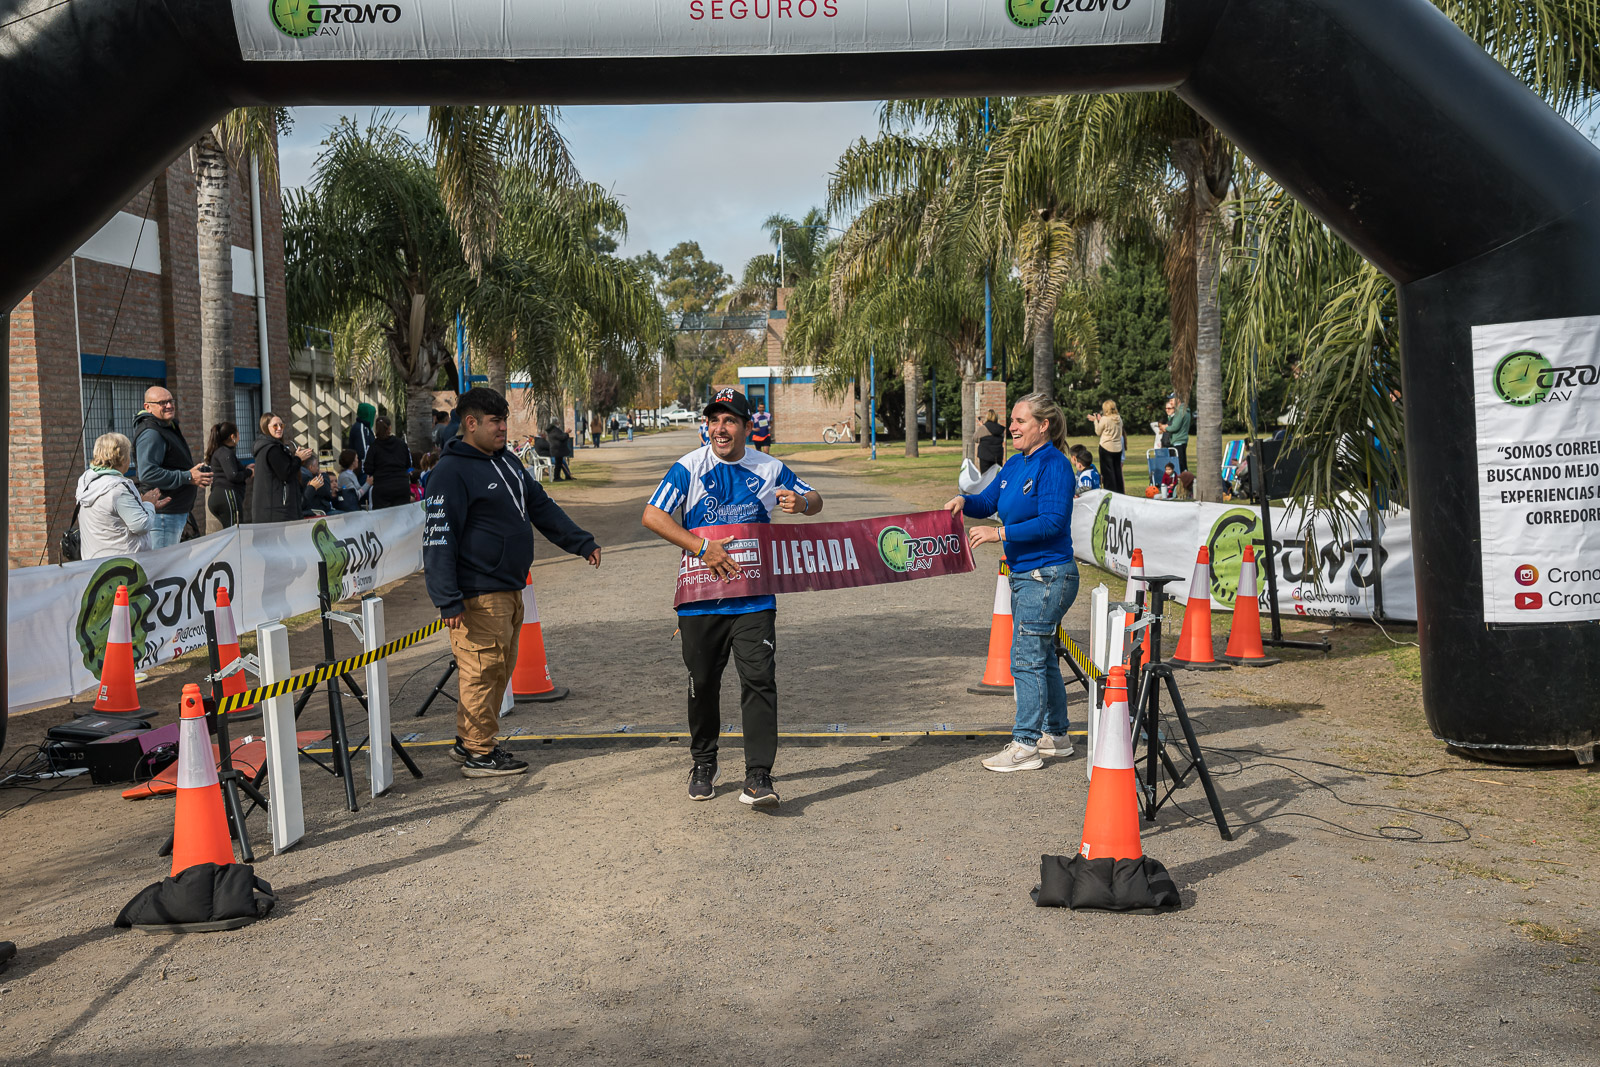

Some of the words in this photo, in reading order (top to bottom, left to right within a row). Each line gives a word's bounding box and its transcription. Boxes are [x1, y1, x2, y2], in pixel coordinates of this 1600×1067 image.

[307, 4, 402, 24] CRONO
[689, 0, 839, 21] SEGUROS
[1037, 16, 1070, 26] RAV
[307, 26, 340, 37] RAV
[1536, 364, 1600, 389] CRO
[1534, 390, 1573, 404] RAV
[1555, 440, 1600, 457] CORRE
[1487, 465, 1562, 483] BUSCANDO
[1501, 485, 1595, 504] EXPERIENCIAS
[704, 496, 718, 524] 3
[689, 556, 700, 568] La
[771, 537, 860, 576] LLEGADA
[905, 557, 933, 572] RAV
[682, 573, 719, 587] PRIMERO
[743, 568, 761, 579] VOS
